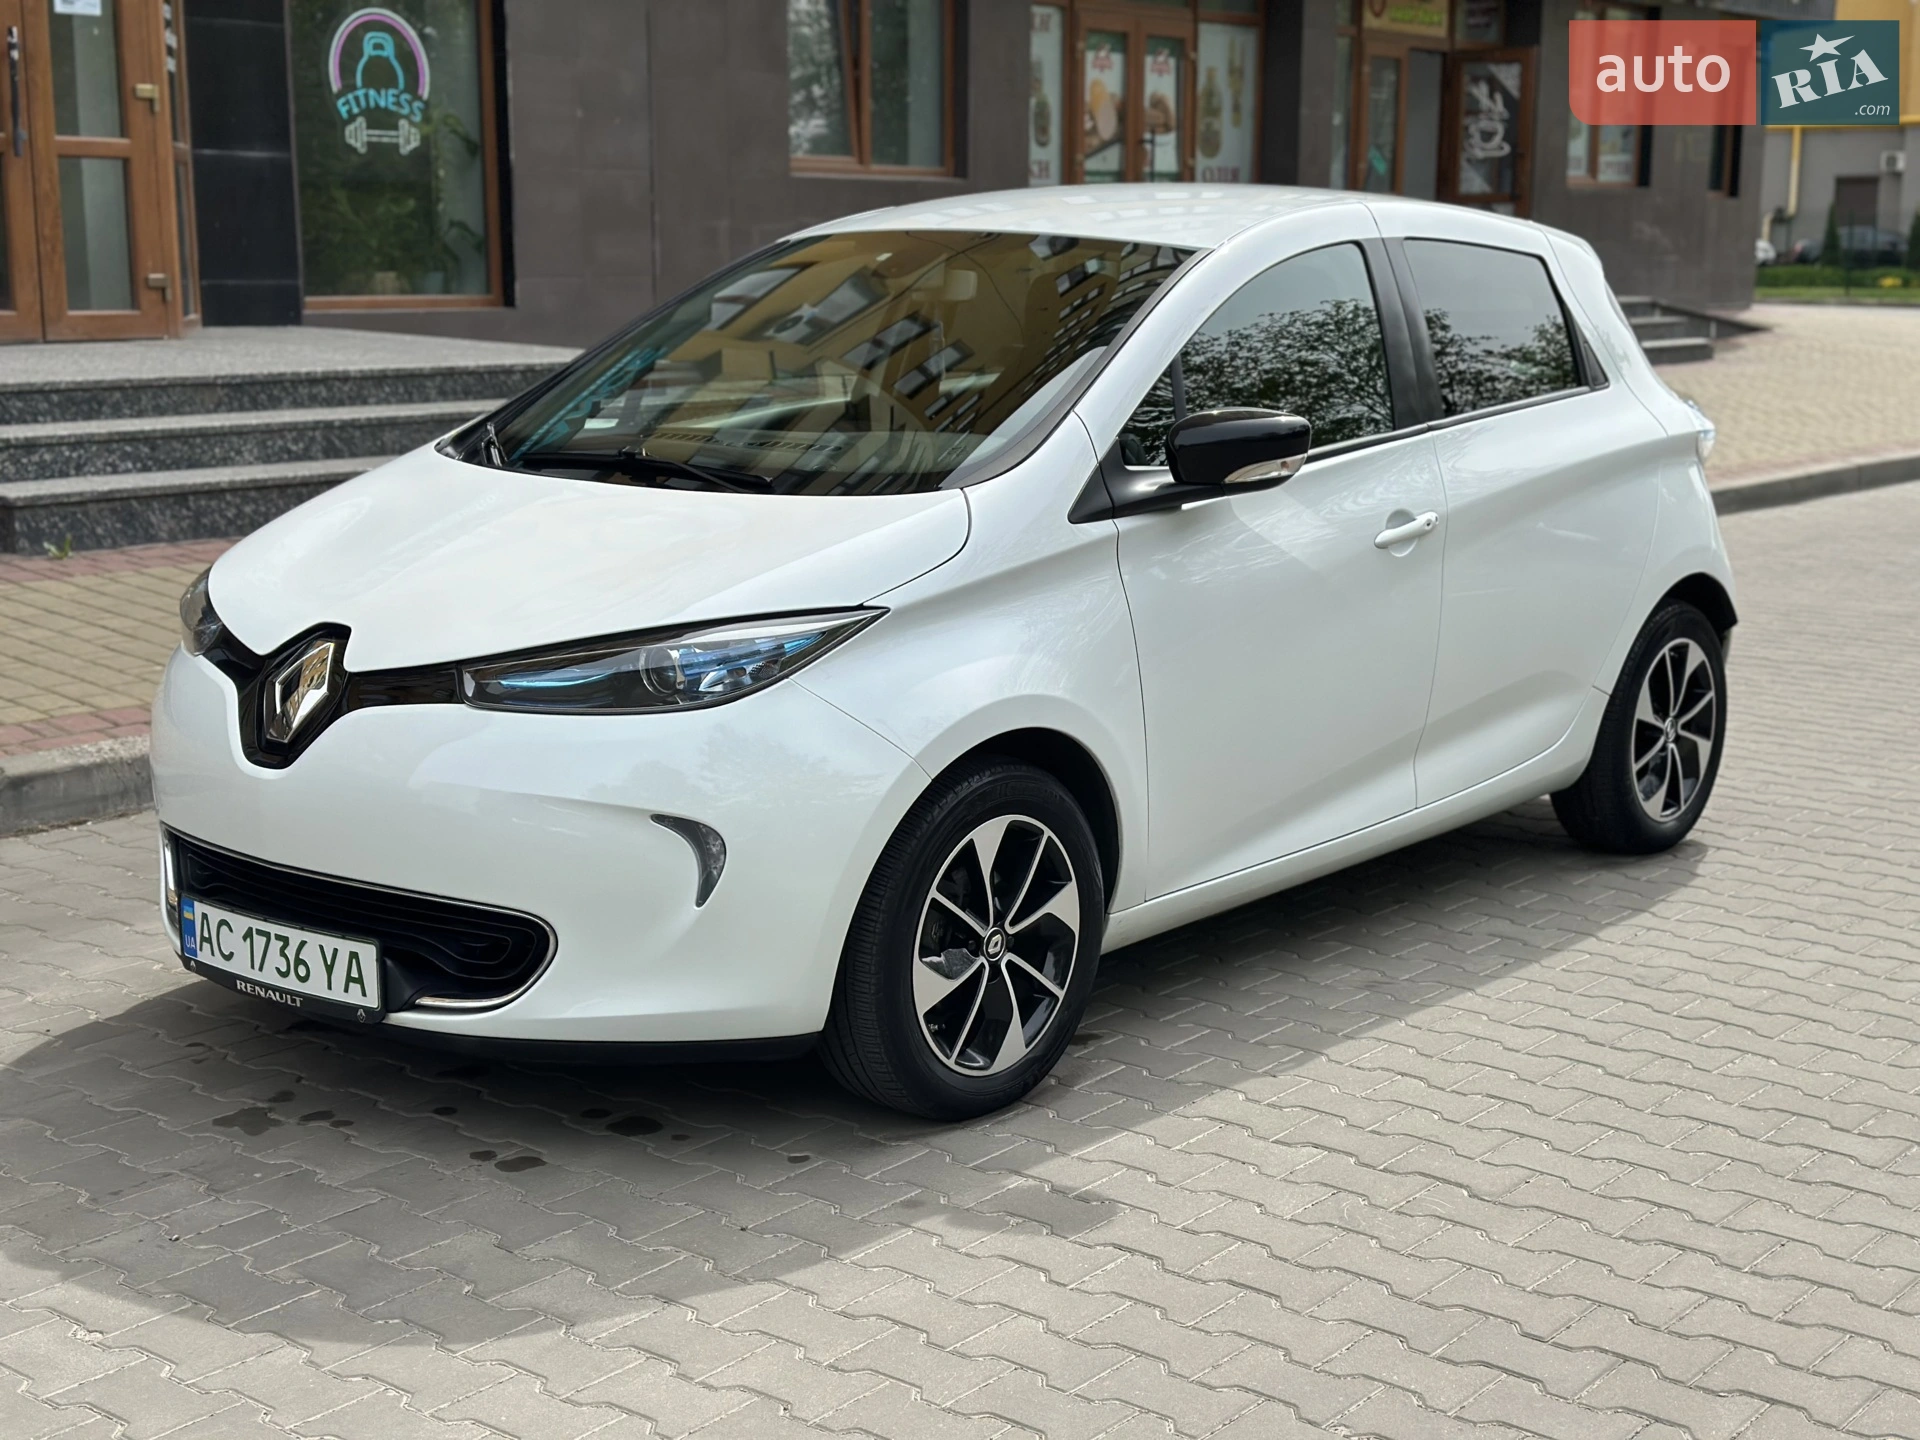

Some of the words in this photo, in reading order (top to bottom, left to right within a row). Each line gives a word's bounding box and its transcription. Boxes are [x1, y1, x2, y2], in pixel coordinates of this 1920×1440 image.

[337, 88, 424, 122] FITNESS
[185, 936, 196, 949] UA
[199, 912, 235, 962] AC
[242, 926, 311, 983] 1736
[318, 944, 367, 997] YA
[236, 980, 303, 1007] RENAULT
